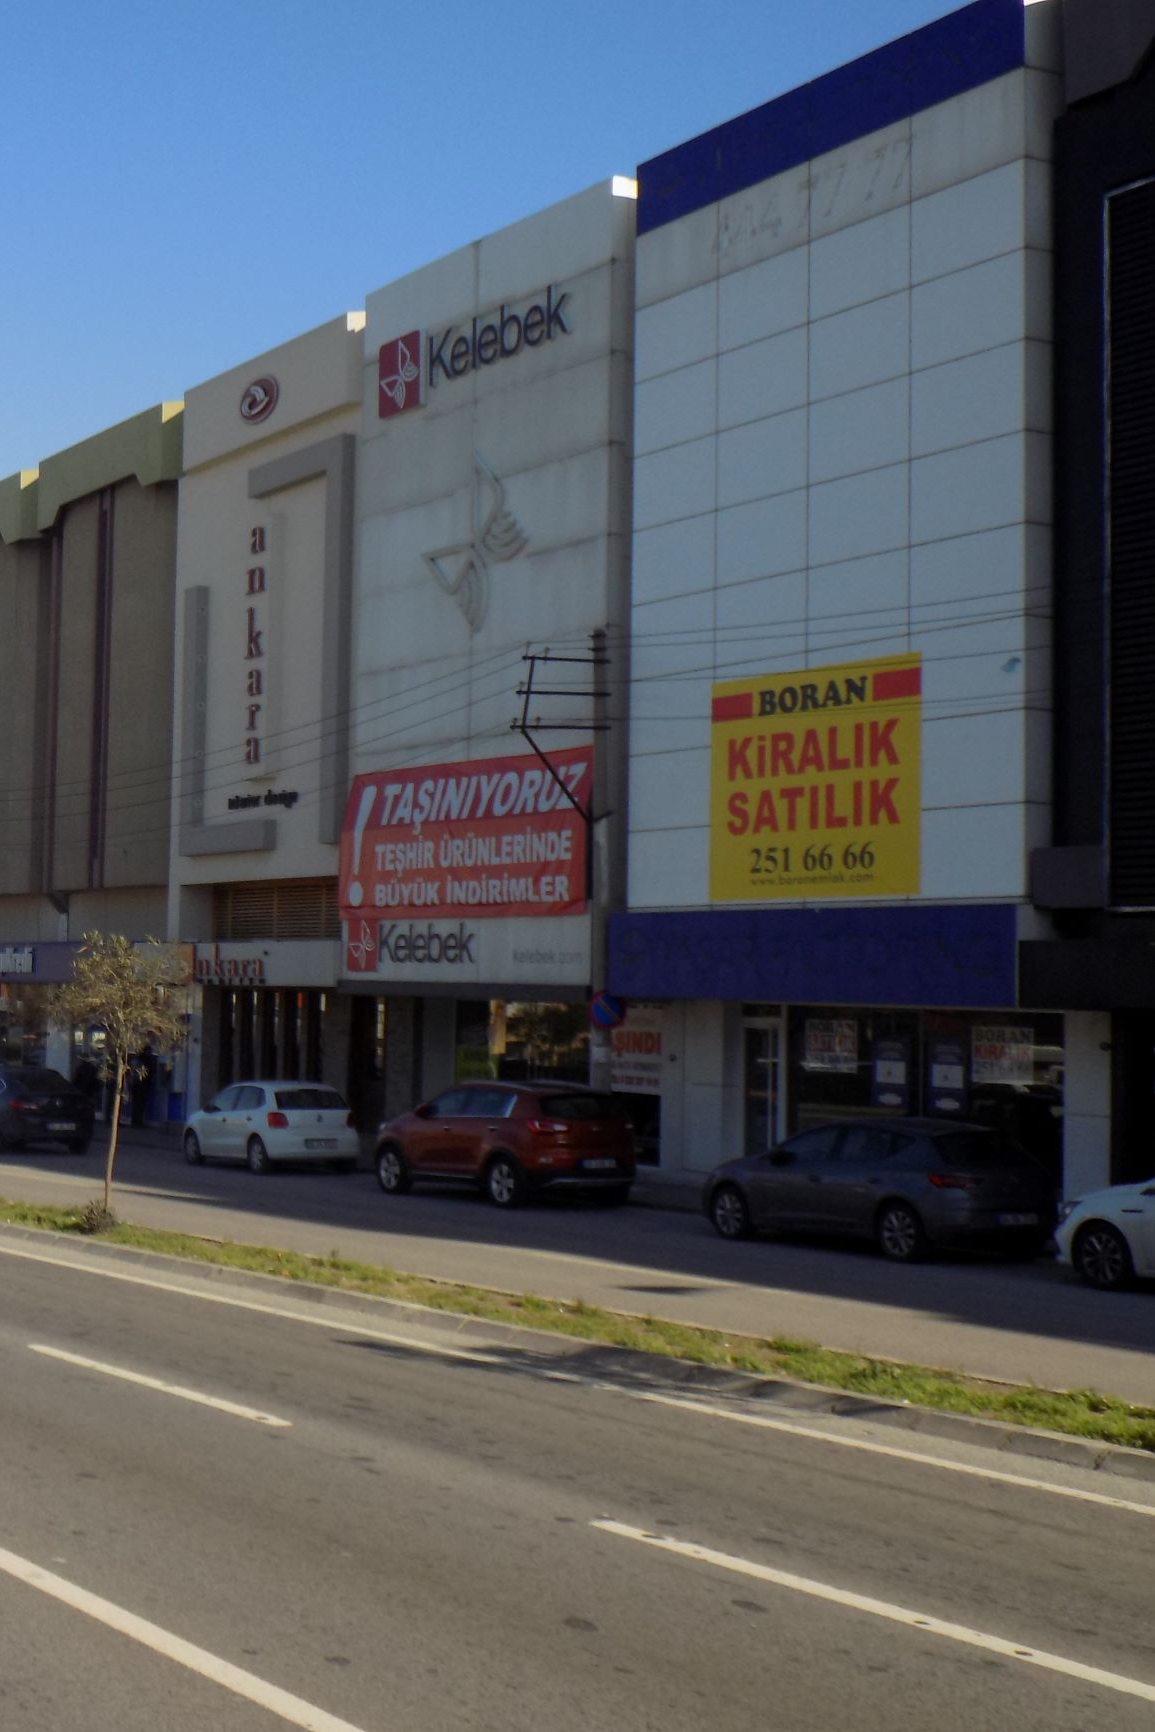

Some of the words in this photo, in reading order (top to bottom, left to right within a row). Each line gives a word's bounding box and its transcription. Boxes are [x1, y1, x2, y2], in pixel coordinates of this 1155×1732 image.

[429, 284, 571, 388] Kelebek
[243, 525, 266, 764] ankara
[758, 675, 867, 716] BORAN
[381, 762, 587, 835] TAŞINIYORUZ
[727, 777, 901, 836] SATILIK
[375, 835, 435, 877] TEŞHİR
[439, 827, 572, 868] ÜRÜNLERİNDE
[750, 846, 791, 874] 251
[803, 843, 834, 872] 66
[842, 841, 875, 870] 66
[374, 879, 441, 907] BÜYÜK
[446, 873, 570, 905] İNDİRİMLER
[378, 922, 476, 964] Kelebek
[613, 1030, 662, 1057] ŞINDI
